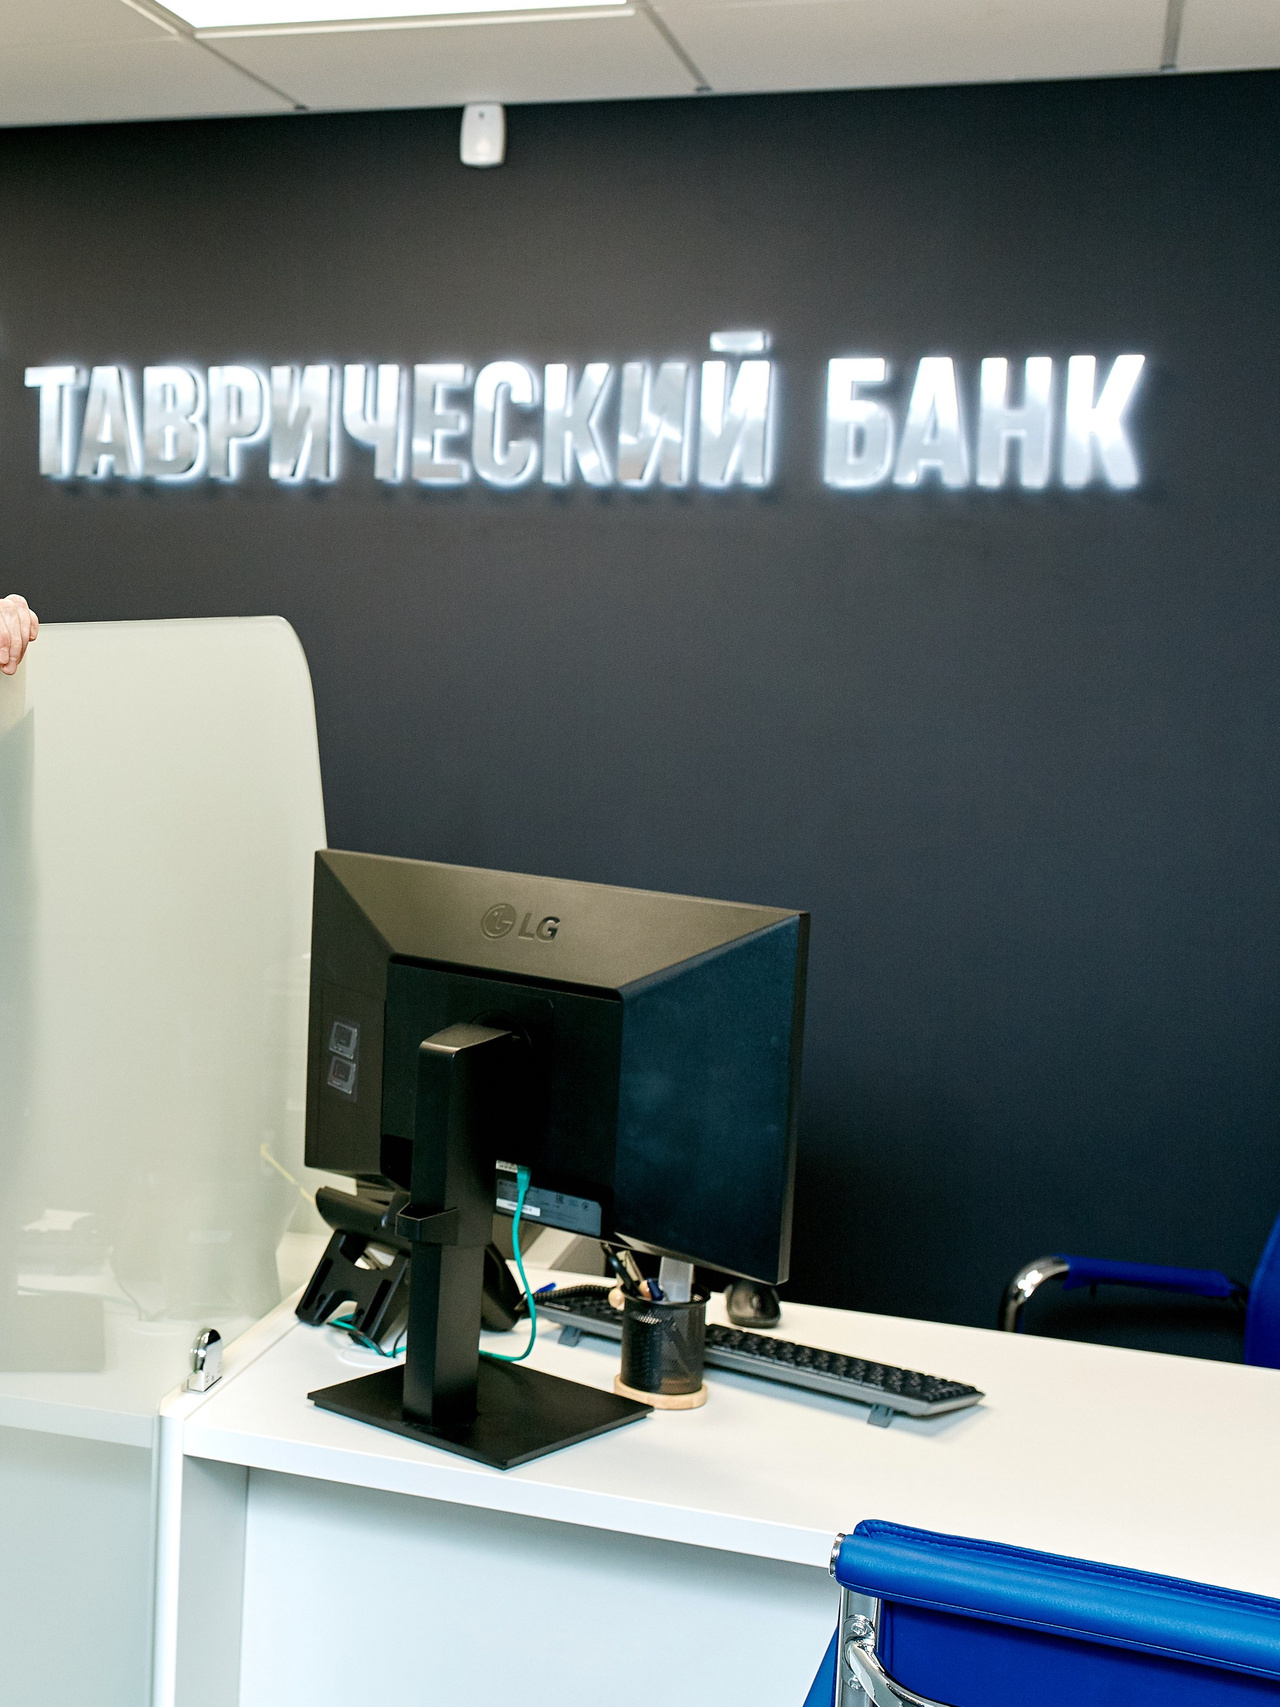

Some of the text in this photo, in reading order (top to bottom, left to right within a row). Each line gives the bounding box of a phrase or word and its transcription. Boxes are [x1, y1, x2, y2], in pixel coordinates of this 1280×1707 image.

[25, 331, 1146, 488] ТАВРИЧЕСКИЙ БАНК
[518, 912, 561, 943] LG
